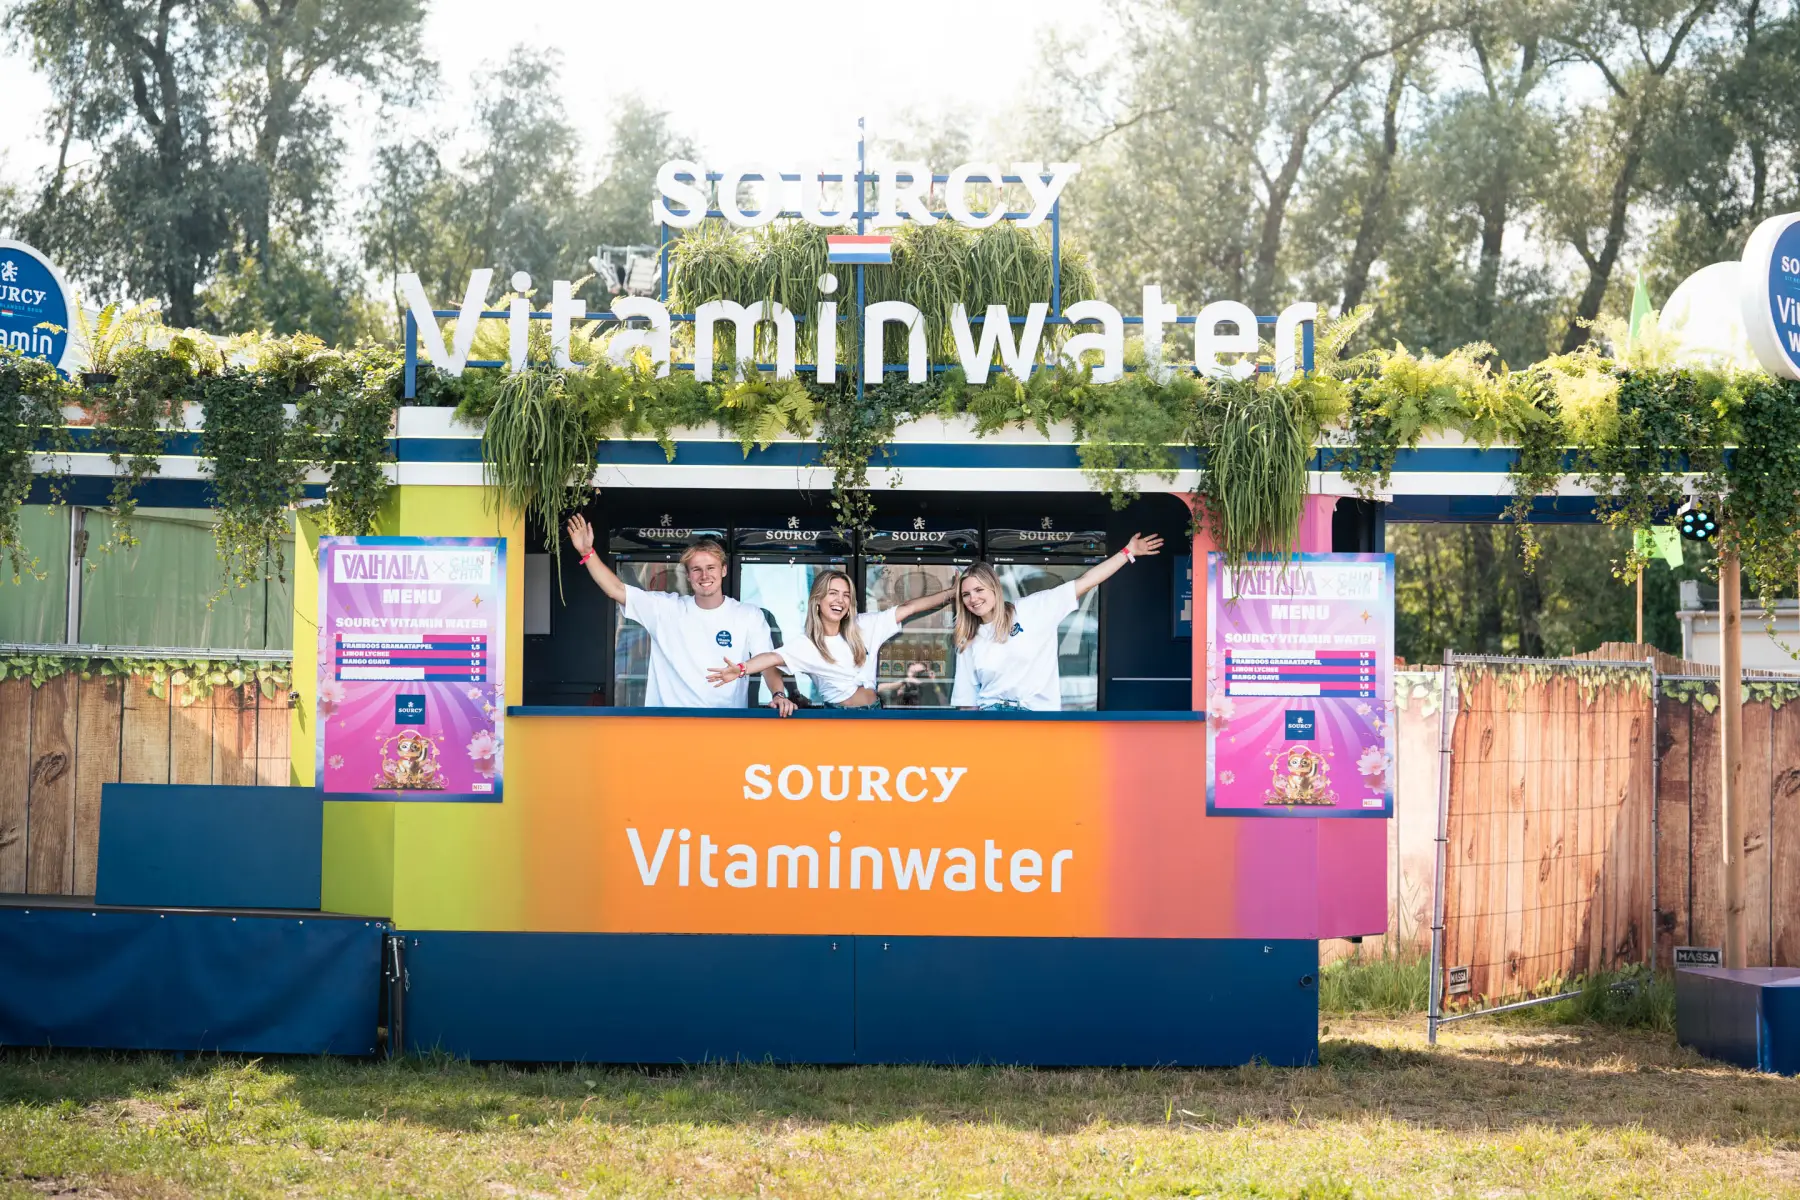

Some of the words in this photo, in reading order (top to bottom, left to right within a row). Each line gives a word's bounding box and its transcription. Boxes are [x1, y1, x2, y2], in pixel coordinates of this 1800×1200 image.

[652, 158, 1081, 230] SOURCY
[397, 267, 1317, 385] Vitaminwater
[638, 528, 693, 538] SOURCY
[766, 531, 821, 541] SOURCY
[891, 531, 946, 541] SOURCY
[1019, 531, 1074, 541] SOURCY
[341, 553, 429, 580] VALHALLA
[383, 589, 442, 604] MENU
[1271, 604, 1330, 620] MENU
[335, 617, 388, 628] SOURCY
[391, 618, 443, 629] VITAMIN
[445, 618, 487, 629] WATER
[1225, 632, 1276, 644] SOURCY
[1277, 633, 1332, 645] VITAMIN
[1333, 634, 1377, 645] WATER
[743, 763, 967, 803] SOURCY
[625, 827, 1073, 893] Vitaminwater
[1679, 951, 1717, 963] MASSA
